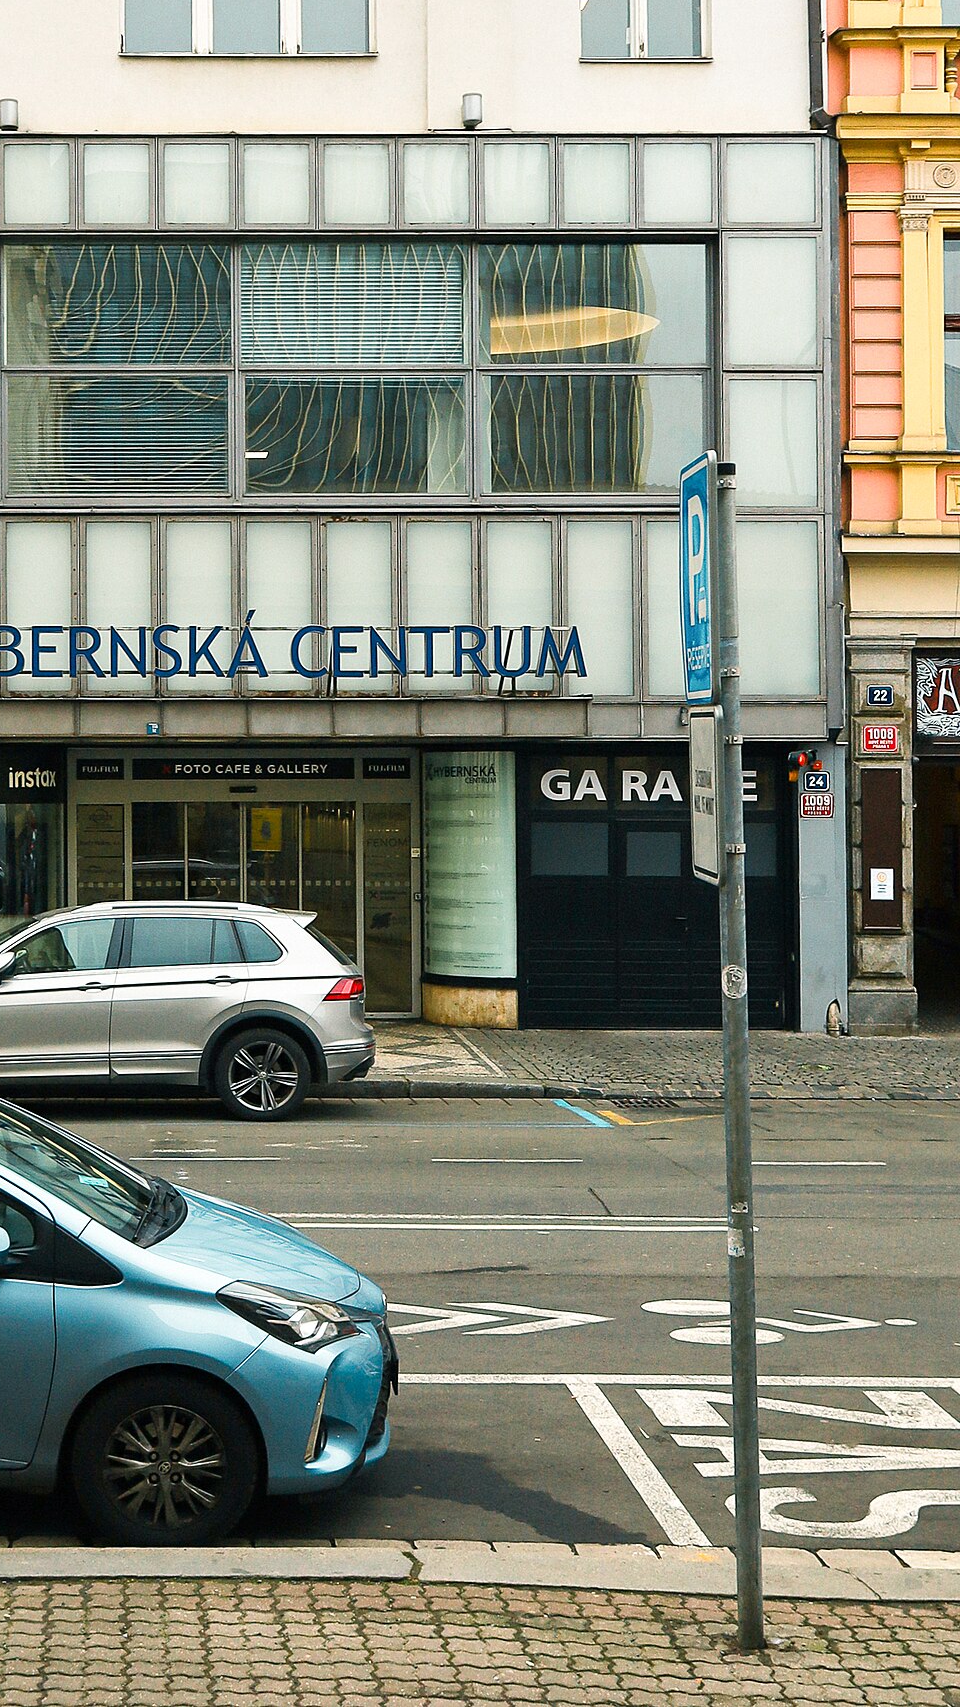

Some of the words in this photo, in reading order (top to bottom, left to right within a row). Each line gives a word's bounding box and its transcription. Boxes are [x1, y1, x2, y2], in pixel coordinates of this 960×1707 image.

[687, 494, 704, 627] P
[290, 625, 588, 678] CENTRUM
[873, 689, 888, 702] 22
[867, 728, 894, 740] 1008
[174, 764, 211, 774] FOTO
[215, 764, 251, 774] CAFE
[254, 764, 263, 774] &
[267, 764, 328, 774] GALLERY
[433, 763, 497, 777] HYBERNSKÁ
[8, 766, 57, 789] instax
[808, 775, 824, 787] 24
[804, 795, 831, 806] 1009
